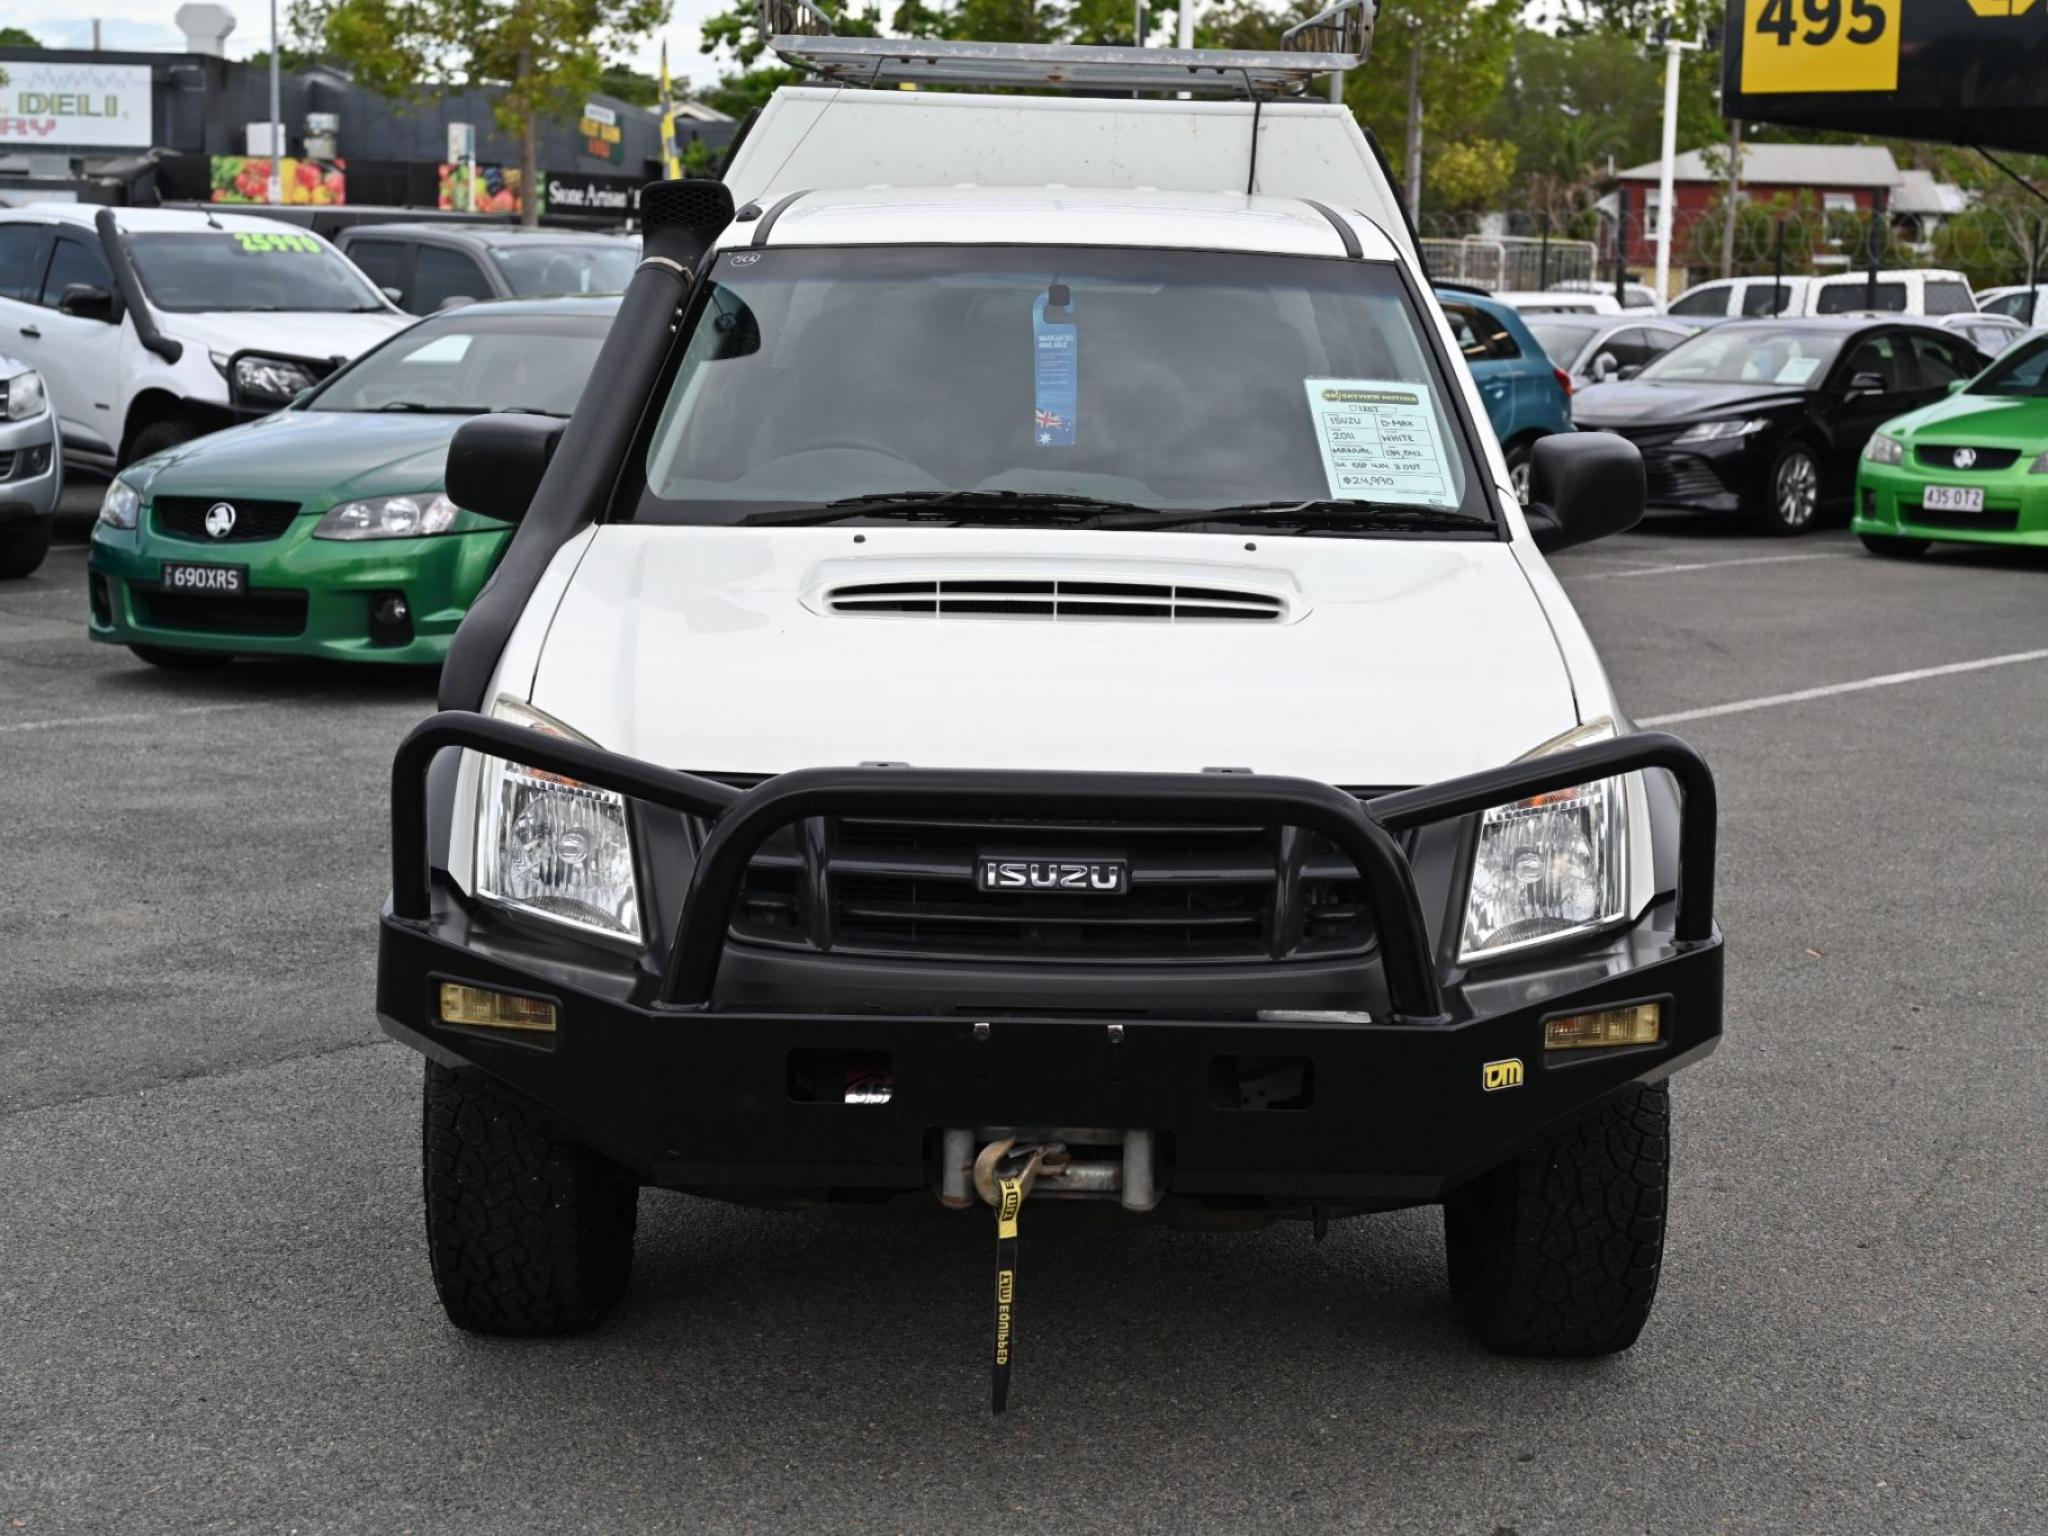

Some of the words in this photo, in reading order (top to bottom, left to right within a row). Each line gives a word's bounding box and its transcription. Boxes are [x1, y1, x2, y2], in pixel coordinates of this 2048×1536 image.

[1756, 0, 1886, 46] 495
[1333, 432, 1356, 440] 2011
[1343, 476, 1394, 486] $24,990
[1927, 488, 1949, 504] 435
[174, 567, 238, 590] 690XRS
[987, 863, 1118, 889] ISUZU
